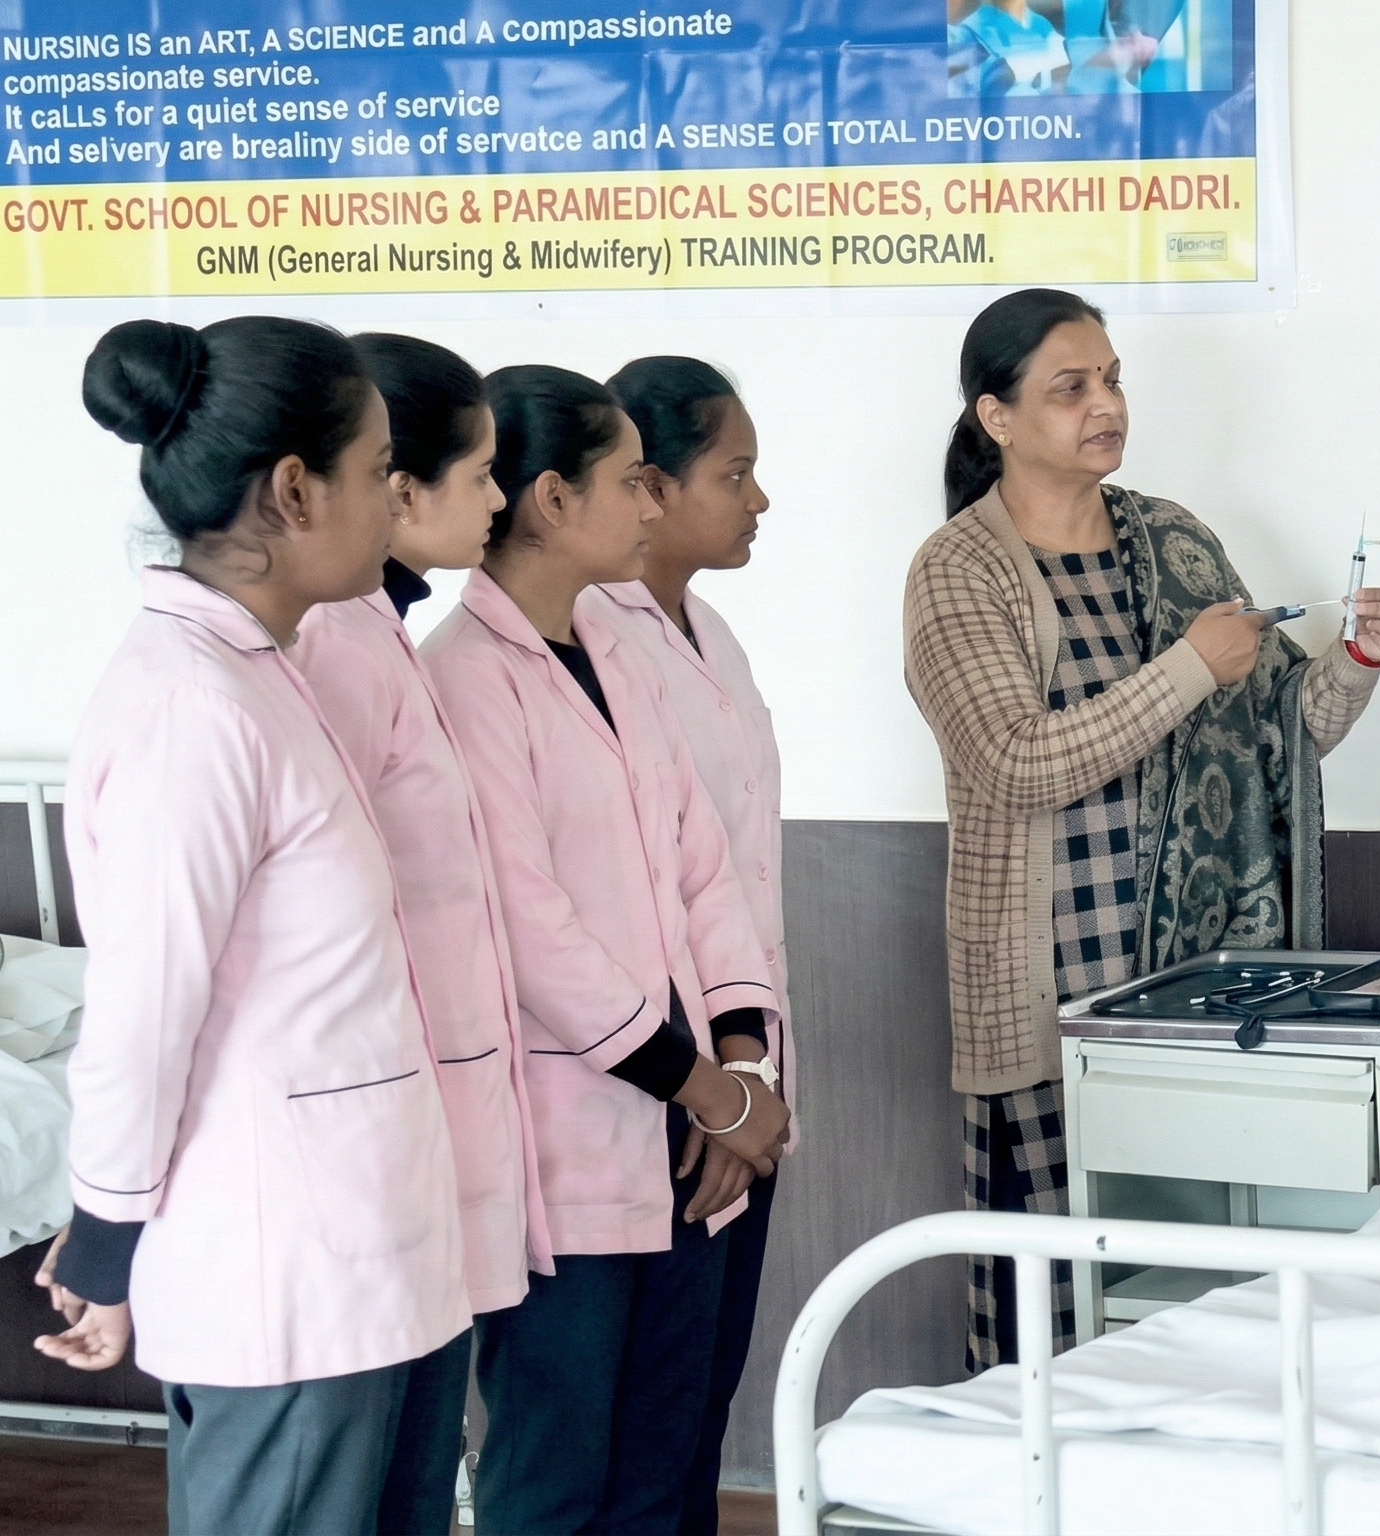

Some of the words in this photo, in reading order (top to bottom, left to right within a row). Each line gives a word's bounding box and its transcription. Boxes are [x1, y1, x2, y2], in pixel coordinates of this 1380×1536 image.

[4, 34, 119, 60] NURSING
[128, 33, 151, 56] IS
[160, 36, 191, 55] an
[198, 30, 255, 56] ART,
[262, 29, 281, 52] A
[289, 23, 404, 51] SCIENCE
[413, 19, 466, 46] and
[476, 21, 495, 43] A
[503, 9, 732, 46] compassionate
[4, 65, 204, 98] compassionate
[213, 60, 319, 87] service.
[6, 105, 22, 130] It
[115, 100, 154, 126] for
[163, 105, 177, 124] a
[187, 97, 257, 130] quiet
[266, 100, 348, 122] sense
[358, 92, 387, 119] of
[396, 90, 499, 118] service
[6, 138, 60, 165] And
[179, 140, 222, 160] are
[232, 131, 342, 163] brealiny
[351, 129, 409, 156] side
[420, 127, 448, 154] of
[593, 122, 647, 151] and
[655, 124, 675, 148] A
[683, 123, 774, 148] SENSE
[783, 122, 820, 145] OF
[828, 120, 916, 144] TOTAL
[926, 115, 1081, 141] DEVOTION.
[4, 199, 93, 232] GOVT.
[105, 196, 237, 230] SCHOOL
[248, 195, 289, 228] OF
[302, 191, 448, 226] NURSING
[460, 190, 481, 224] &
[494, 185, 737, 223] PARAMEDICAL
[748, 180, 931, 221] SCIENCES,
[944, 177, 1104, 214] CHARKHI
[1120, 175, 1239, 211] DADRI.
[197, 246, 258, 275] GNM
[269, 244, 378, 281] (General
[389, 242, 492, 278] Nursing
[503, 241, 521, 270] &
[531, 238, 671, 275] Midwifery)
[681, 236, 821, 267] TRAINING
[832, 234, 993, 265] PROGRAM.
